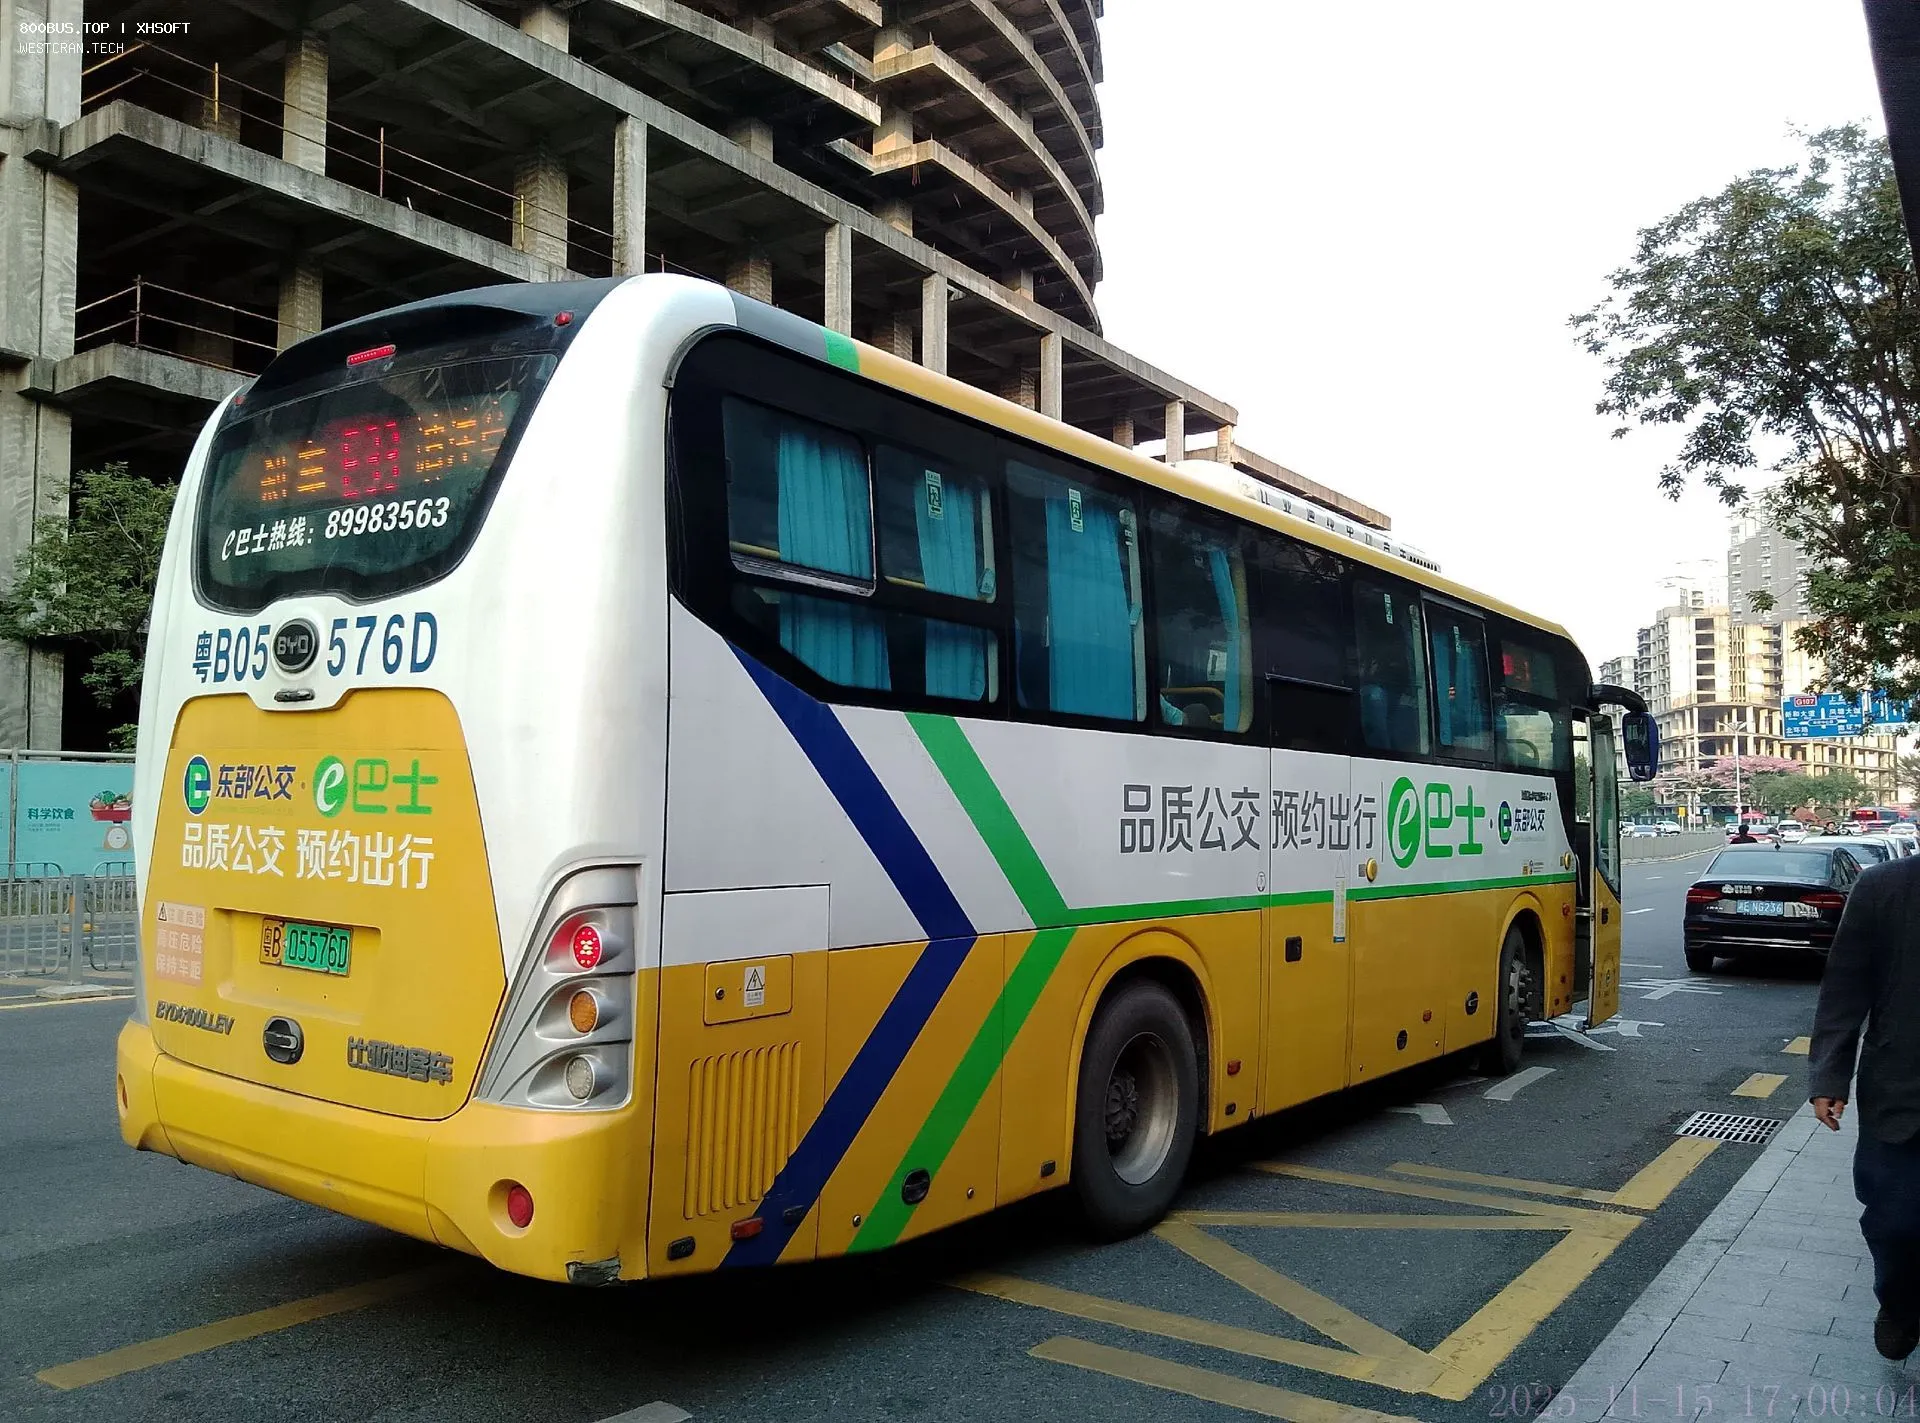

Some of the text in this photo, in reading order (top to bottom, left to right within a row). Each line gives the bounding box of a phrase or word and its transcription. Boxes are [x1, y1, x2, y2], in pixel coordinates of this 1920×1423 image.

[324, 496, 451, 540] 89983563
[276, 634, 309, 655] BYD
[326, 611, 439, 677] 576D
[1796, 698, 1815, 706] G107
[215, 764, 297, 800] 东部公交
[27, 807, 75, 820] 科学饮食
[1119, 783, 1262, 855] 品质公交
[1272, 789, 1378, 852] 预约出行
[1514, 808, 1546, 832] 东部公交
[181, 822, 435, 890] 品质公交 预约出行
[156, 952, 202, 981] 保持车距
[347, 1035, 454, 1087] 比亚迪客车
